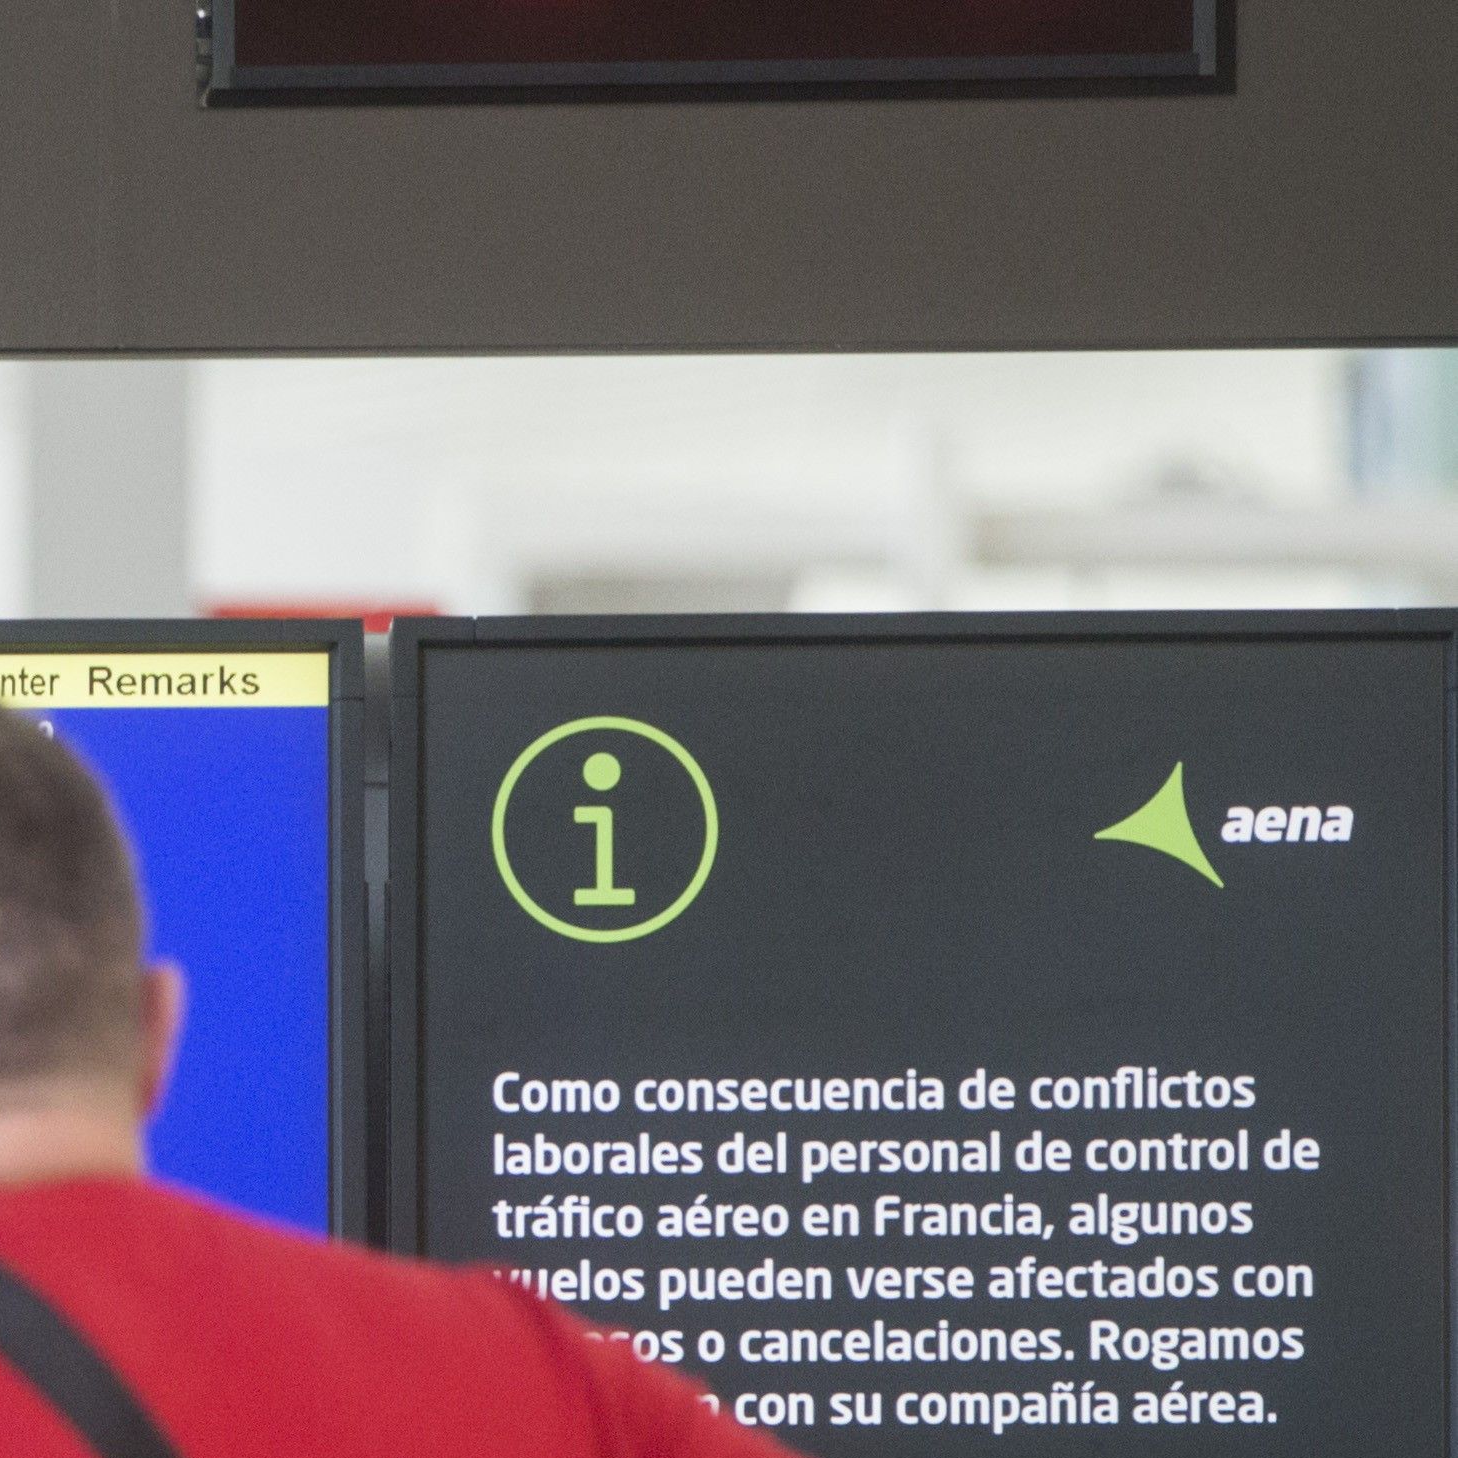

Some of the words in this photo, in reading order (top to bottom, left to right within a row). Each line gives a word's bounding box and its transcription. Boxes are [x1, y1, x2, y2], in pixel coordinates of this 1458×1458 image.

[88, 665, 260, 696] Remarks
[1221, 805, 1354, 843] aena
[493, 1071, 621, 1113] Como
[634, 1068, 945, 1112] consecuencia
[958, 1068, 1016, 1110] de
[1030, 1066, 1256, 1110] conflictos
[494, 1132, 704, 1175] laborales
[717, 1131, 787, 1174] del
[802, 1130, 1001, 1184] personal
[1015, 1130, 1072, 1172] de
[1085, 1129, 1249, 1172] control
[1263, 1128, 1320, 1170] de
[493, 1194, 644, 1238] tráfico
[656, 1193, 789, 1237] aéreo
[802, 1203, 860, 1237] en
[874, 1193, 1055, 1245] Francia,
[1068, 1193, 1254, 1245] algunos
[659, 1258, 832, 1311] pueden
[846, 1266, 975, 1300] verse
[988, 1255, 1219, 1299] afectados
[1233, 1265, 1313, 1298] con
[697, 1330, 726, 1363] o
[739, 1319, 1075, 1362] cancelaciones.
[1090, 1319, 1305, 1371] Rogamos
[734, 1392, 815, 1426] con
[829, 1392, 882, 1426] su
[895, 1380, 1119, 1435] compañía
[1132, 1380, 1277, 1424] aérea.
